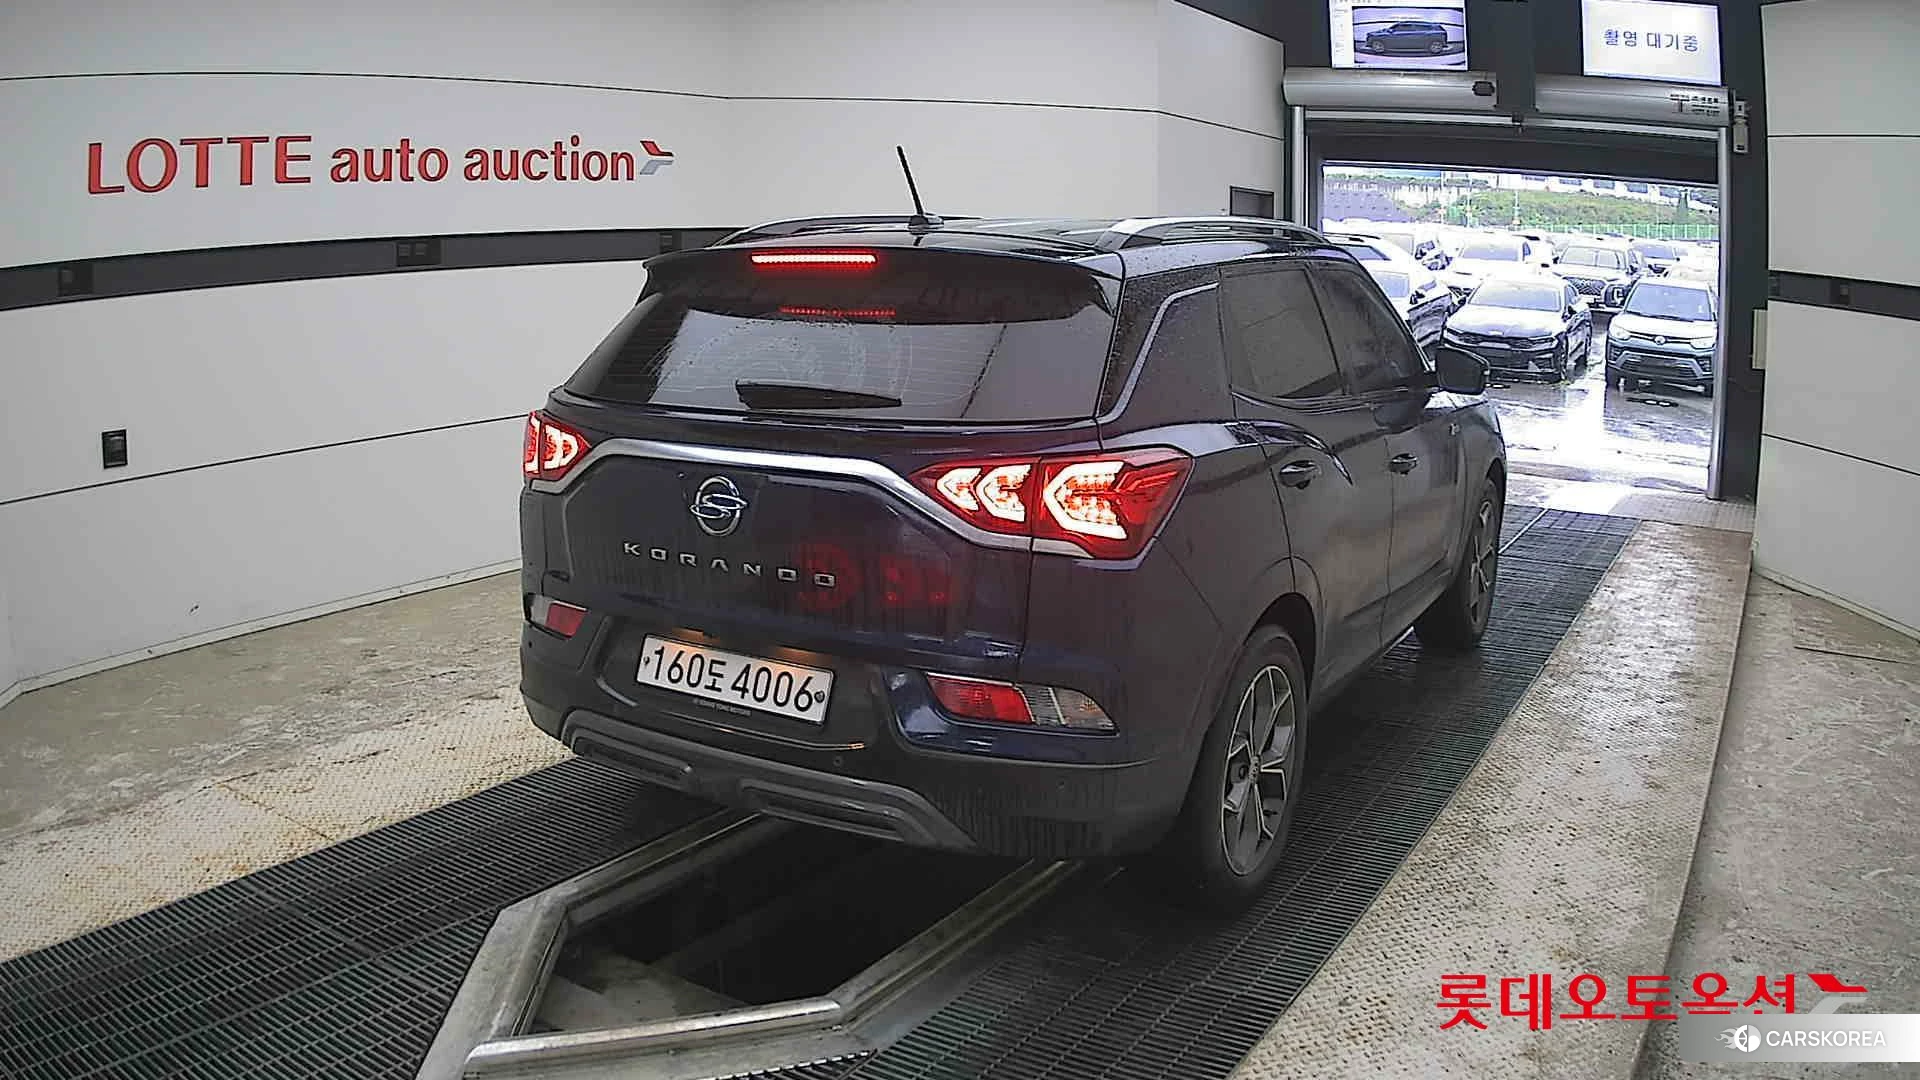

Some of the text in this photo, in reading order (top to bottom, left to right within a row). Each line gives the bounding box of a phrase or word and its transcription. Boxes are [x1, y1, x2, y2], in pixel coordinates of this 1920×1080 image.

[1646, 32, 1698, 52] 대기중
[87, 134, 635, 194] LOTTE auto auction
[623, 542, 836, 587] KORANDO
